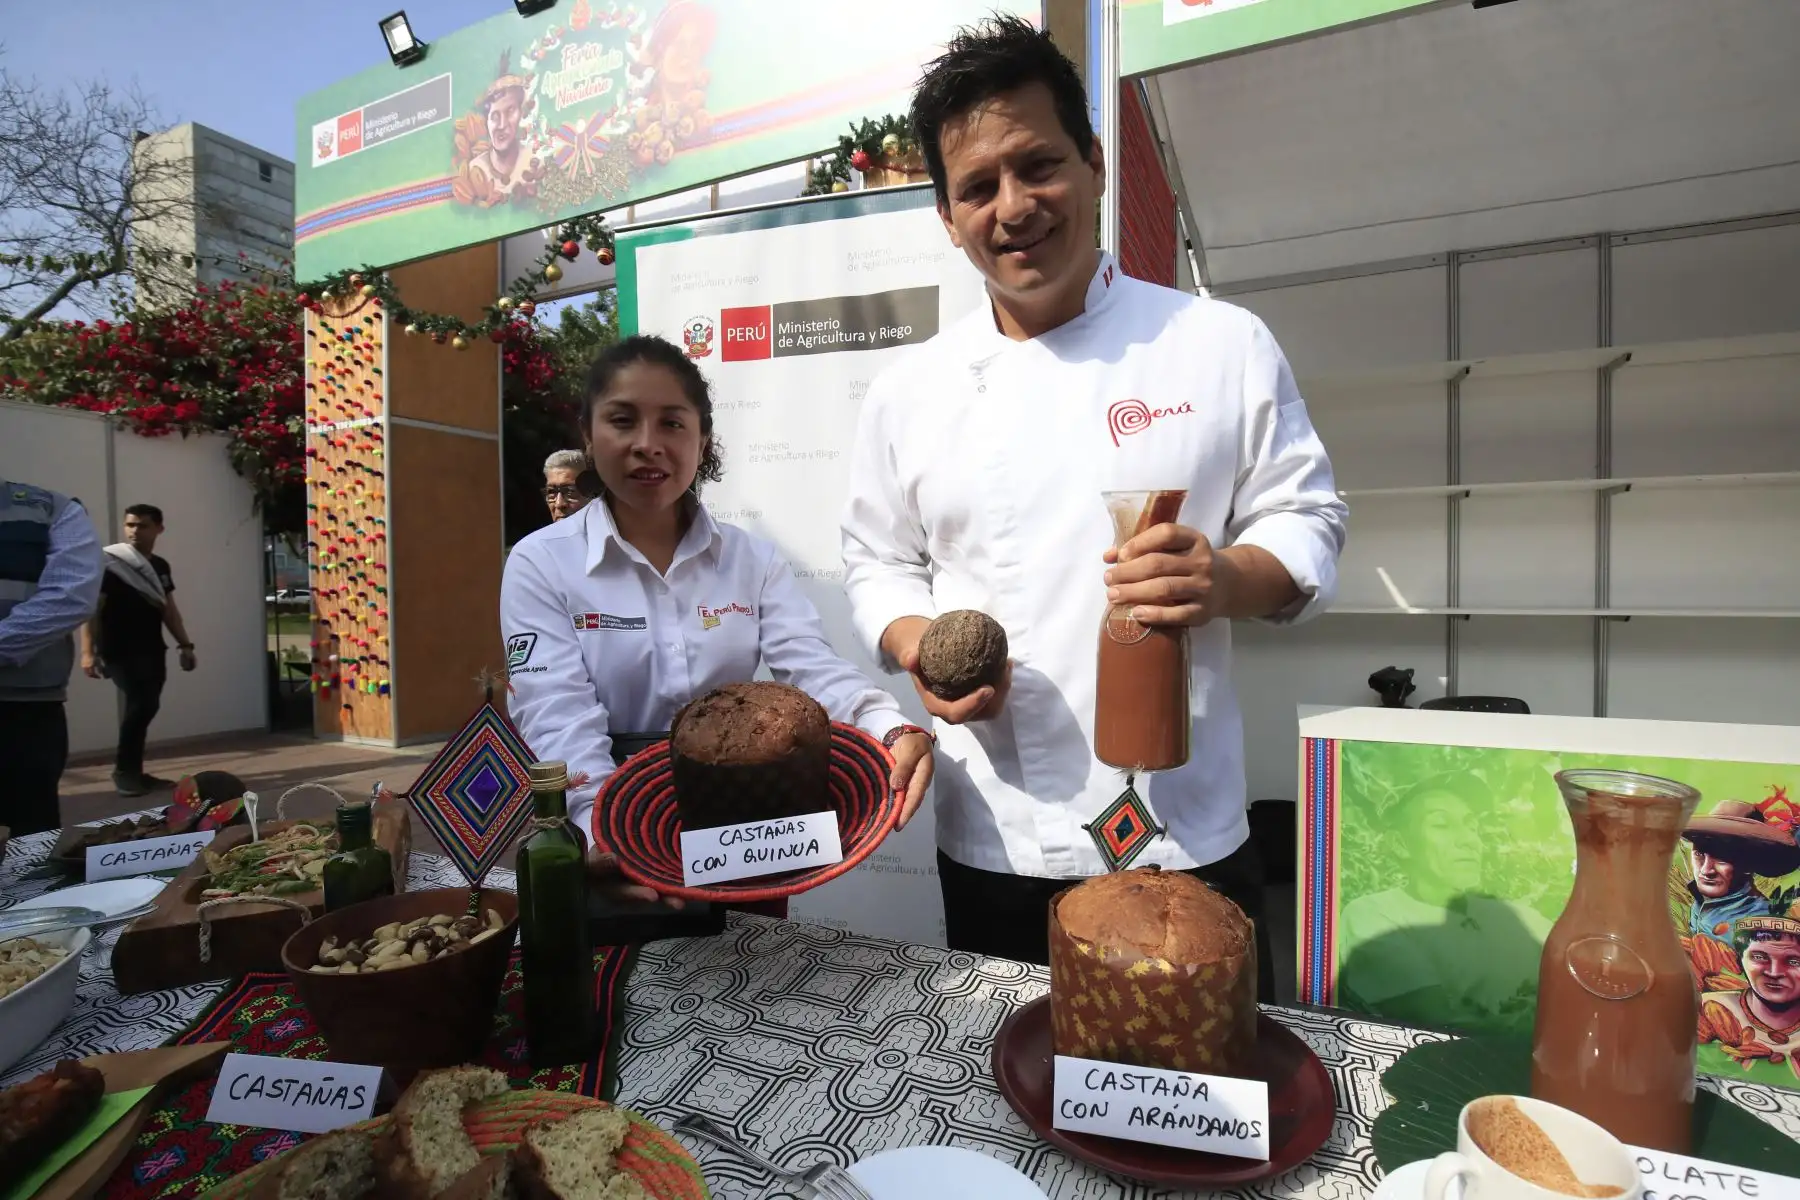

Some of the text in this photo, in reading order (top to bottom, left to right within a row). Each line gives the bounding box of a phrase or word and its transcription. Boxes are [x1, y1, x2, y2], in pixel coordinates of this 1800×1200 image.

[339, 122, 360, 142] PERÚ
[365, 111, 399, 129] Ministerio
[365, 108, 438, 141] de Agricultura y Riego
[727, 322, 767, 343] PERÚ
[778, 318, 841, 334] Ministerio
[778, 325, 913, 349] de Agricultura y Riego
[1107, 399, 1196, 447] Perú
[719, 820, 806, 846] CASTAÑAS
[100, 840, 205, 867] CASTAÑAS
[692, 838, 819, 874] CON QUINUA
[868, 852, 901, 863] nisterio
[229, 1073, 366, 1111] CASTAÑAS
[1084, 1068, 1209, 1102] CASTAÑA
[1060, 1099, 1262, 1139] CON ARÁNDANOS
[1636, 1156, 1760, 1197] OLATE
